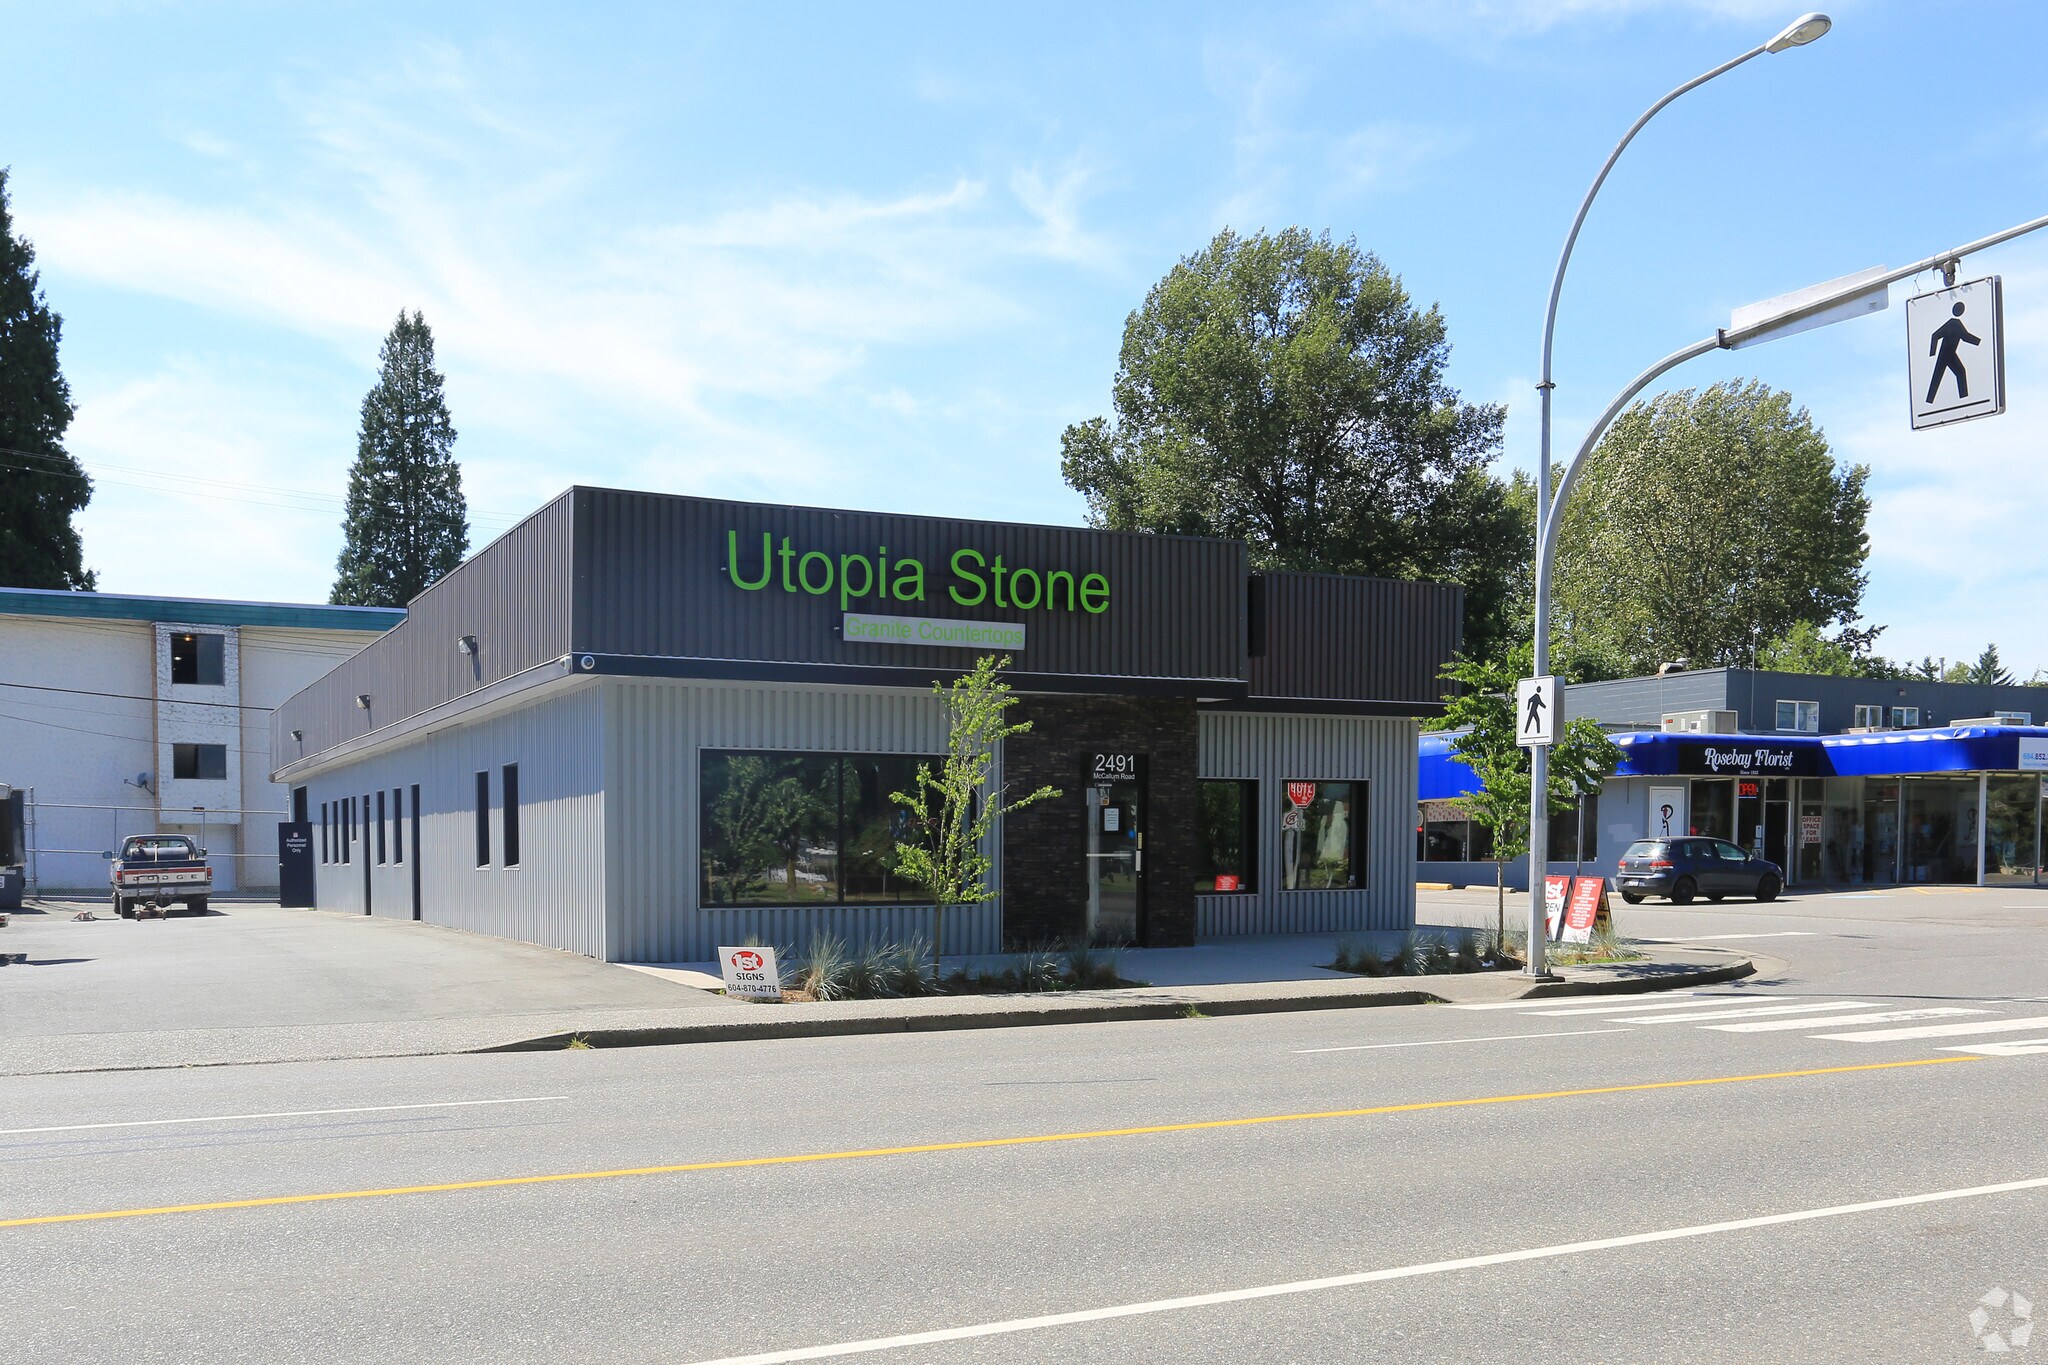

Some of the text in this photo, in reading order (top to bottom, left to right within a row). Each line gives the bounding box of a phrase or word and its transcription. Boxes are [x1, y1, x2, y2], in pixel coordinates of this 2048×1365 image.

[728, 530, 1110, 614] Utopia Stone
[846, 617, 1024, 646] Granite Countertops
[1095, 754, 1134, 771] 2491
[1704, 747, 1793, 772] Rosebay Florist
[1093, 772, 1120, 780] McCallum
[1739, 783, 1757, 796] OPEN
[1545, 902, 1561, 913] PEN
[736, 972, 765, 981] SIGNS
[727, 984, 777, 993] 604-870-4776
